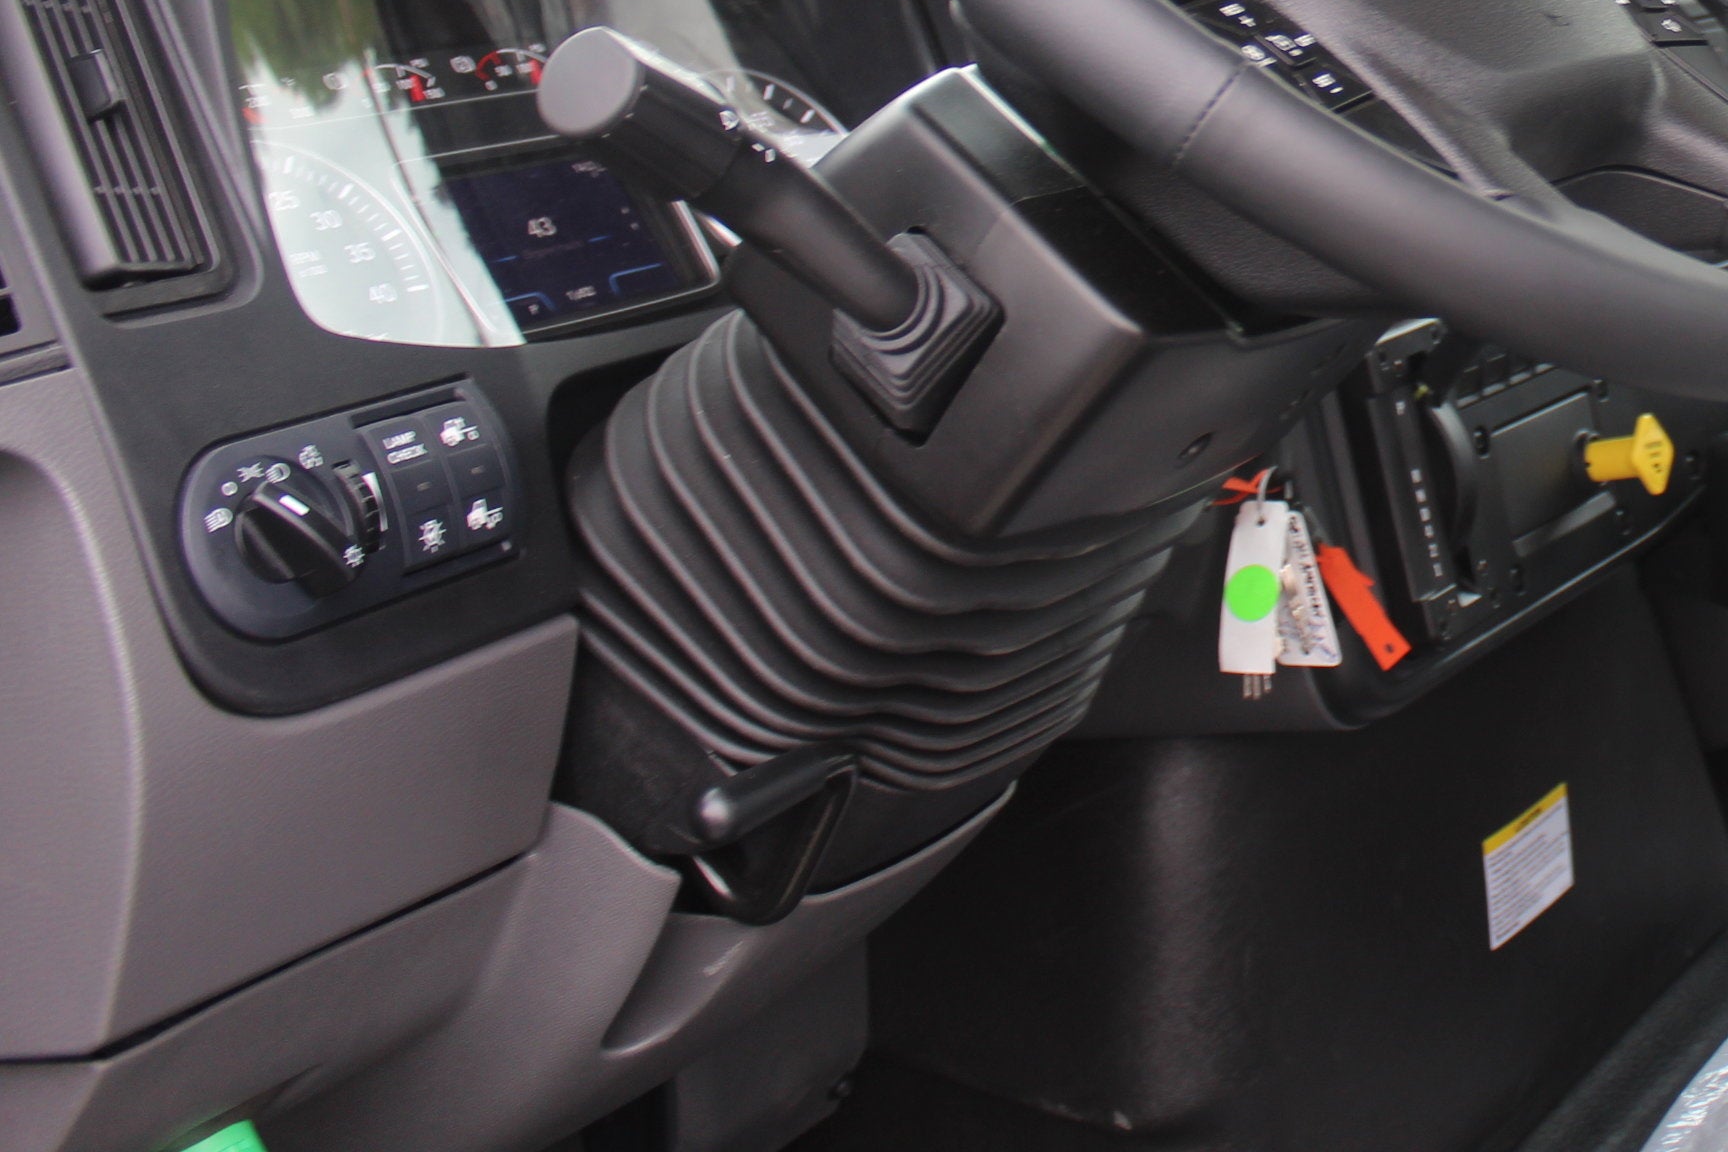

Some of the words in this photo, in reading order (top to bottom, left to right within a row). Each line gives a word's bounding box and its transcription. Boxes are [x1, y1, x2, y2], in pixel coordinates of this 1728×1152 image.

[310, 209, 343, 231] 30
[528, 216, 557, 237] 43
[344, 242, 376, 264] 35
[368, 283, 398, 304] 40
[382, 431, 416, 450] LAMP
[387, 443, 428, 464] CHECK
